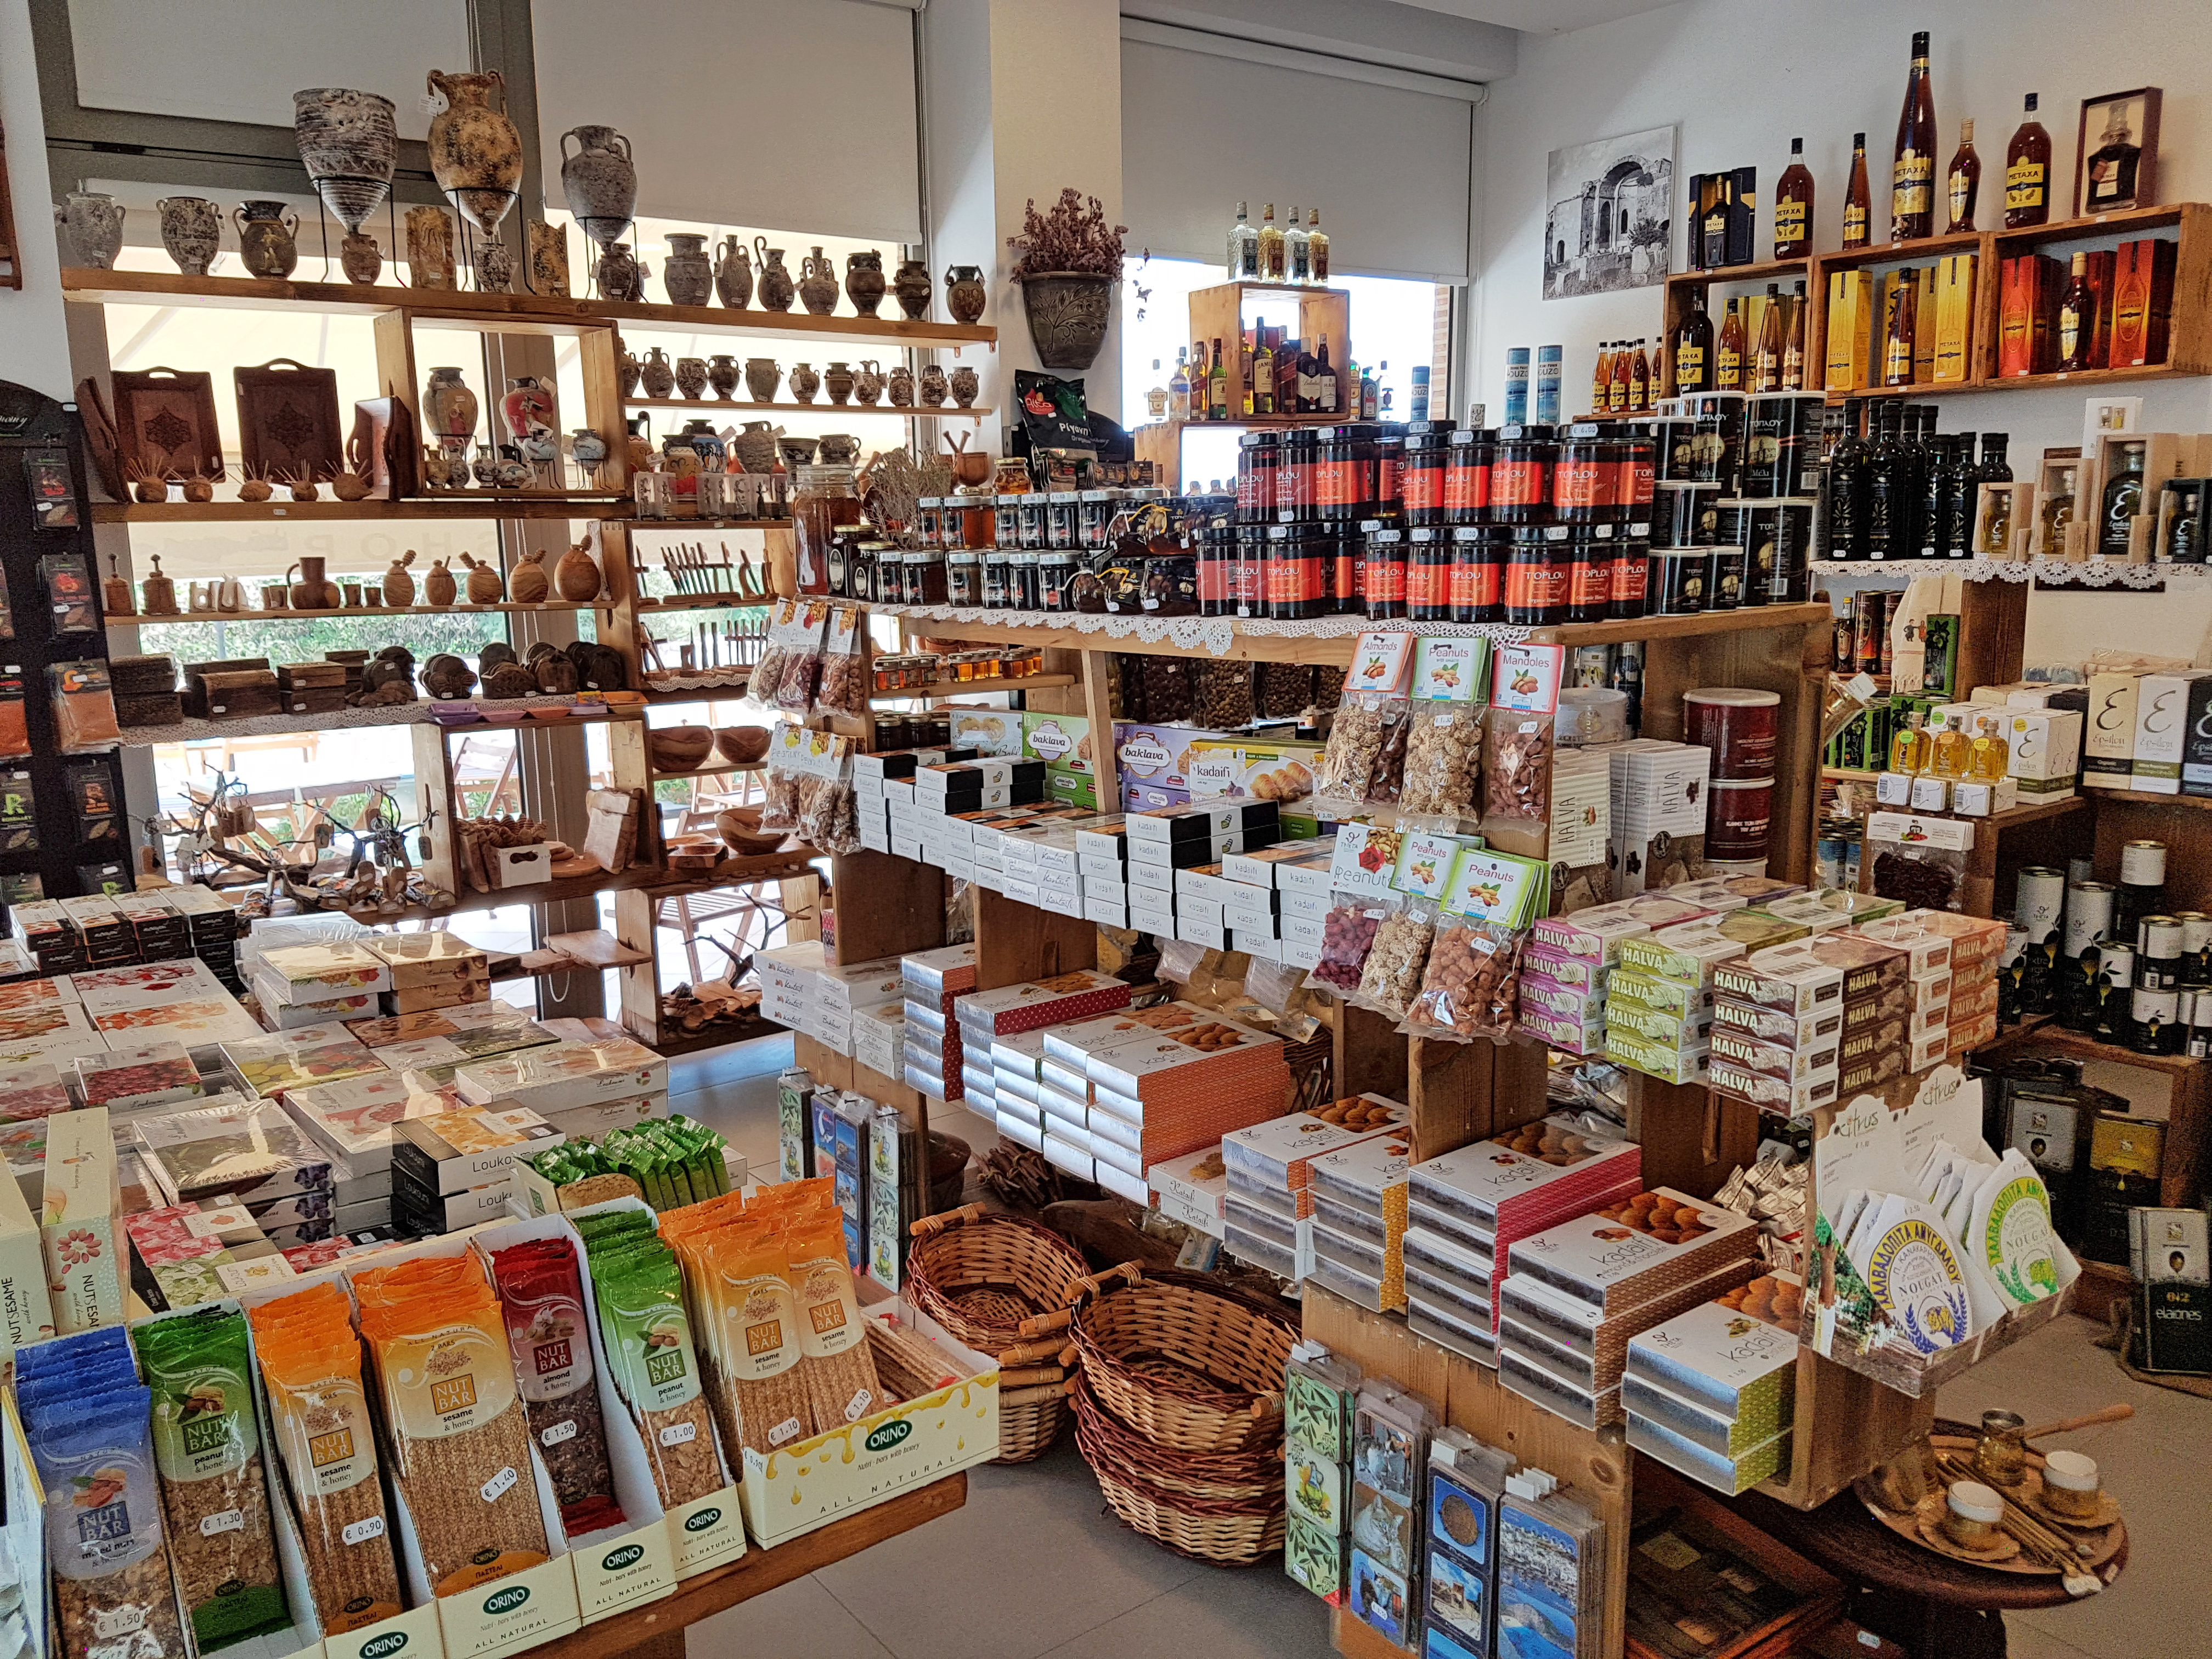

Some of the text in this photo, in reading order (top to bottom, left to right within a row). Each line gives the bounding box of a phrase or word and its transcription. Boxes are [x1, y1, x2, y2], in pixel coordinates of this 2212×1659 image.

[1894, 166, 1926, 177] METAXA
[2008, 170, 2039, 180] METAXA
[1776, 208, 1801, 217] METAXA
[1558, 470, 1598, 478] TOPLOU
[1268, 567, 1300, 575] TOPLOU
[1368, 568, 1404, 577] TOPLOU
[1450, 571, 1481, 579] TOPLOU
[1523, 571, 1565, 580] TOPLOU
[1363, 641, 1397, 652] Almonds
[1429, 647, 1469, 658] Peanuts
[1503, 655, 1549, 668] Mandoles
[1032, 735, 1066, 747] baklava
[1125, 747, 1163, 760] baklava
[1197, 765, 1231, 778] kadaifi
[1662, 770, 1681, 815] HALVA
[1558, 797, 1576, 844] HALVA
[1410, 842, 1447, 858] Peanuts
[1469, 865, 1514, 883] Peanuts
[1480, 941, 1494, 951] 1.30
[1536, 927, 1571, 950] HALVA
[1956, 938, 1980, 958] HALVA
[1525, 956, 1558, 976] HALVA
[1623, 946, 1663, 969] HALVA
[1611, 977, 1649, 1000] HALVA
[1714, 970, 1757, 996] HALVA
[1848, 969, 1878, 992] HALVA
[1521, 985, 1553, 1005] HALVA
[1608, 1007, 1645, 1031] HALVA
[1715, 1004, 1758, 1029] HALVA
[1848, 1003, 1876, 1025] HALVA
[1609, 1039, 1645, 1063] HALVA
[1712, 1036, 1753, 1062] HALVA
[1844, 1035, 1873, 1058] HALVA
[1712, 1069, 1753, 1094] HALVA
[1923, 1077, 1957, 1105] citrus
[1839, 1108, 1878, 1138] citrus
[1283, 1127, 1345, 1149] kadaifi
[1483, 1159, 1548, 1186] kadaifi
[478, 1191, 512, 1208] Louk
[1589, 1235, 1659, 1266] kadaifi
[1899, 1272, 1943, 1295] NOUGAT
[1, 1276, 23, 1344] NUTSESAME
[813, 1305, 838, 1319] NUT
[816, 1314, 843, 1330] BAR
[750, 1324, 776, 1340] NUT
[437, 1340, 456, 1350] BARS
[751, 1334, 778, 1351] BAR
[1717, 1327, 1787, 1362] kadaifi
[538, 1345, 566, 1360] NUT
[650, 1353, 678, 1371] NUT
[755, 1352, 780, 1364] sesame
[540, 1354, 569, 1372] BAR
[762, 1360, 781, 1371] honey
[543, 1371, 571, 1384] almond
[652, 1365, 683, 1384] BAR
[436, 1379, 468, 1398] NUT
[550, 1379, 572, 1391] honey
[658, 1383, 684, 1397] peanut
[439, 1391, 472, 1410] BAR
[666, 1391, 686, 1403] honey
[847, 1391, 870, 1419] € 1.10
[443, 1408, 473, 1423] sesame
[452, 1418, 475, 1430] honey
[188, 1420, 223, 1439] NUT
[544, 1423, 575, 1441] € 1.50
[662, 1426, 694, 1441] € 1.00
[770, 1421, 798, 1441] € 1.10
[870, 1425, 909, 1448] ORINO
[190, 1432, 226, 1451] BAR
[313, 1432, 348, 1451] NUT
[890, 1449, 902, 1460] with
[904, 1442, 921, 1455] honey
[315, 1445, 349, 1464] BAR
[320, 1463, 352, 1486] sesame &
[329, 1471, 352, 1486] honey
[484, 1469, 515, 1498] € 1.40
[820, 1455, 956, 1514] ALL NATURAL
[83, 1507, 121, 1527] NUT
[204, 1512, 240, 1530] € 1.30
[689, 1511, 718, 1528] ORINO
[87, 1520, 125, 1541] BAR
[346, 1520, 381, 1539] € 0.90
[607, 1548, 640, 1567] ORINO
[489, 1589, 525, 1609] ORINO
[596, 1577, 662, 1606] ALL NATURAL
[99, 1612, 140, 1633] € 1.50
[475, 1638, 494, 1649] ALL
[501, 1618, 548, 1638] NATURAL
[365, 1635, 403, 1657] ORINO
